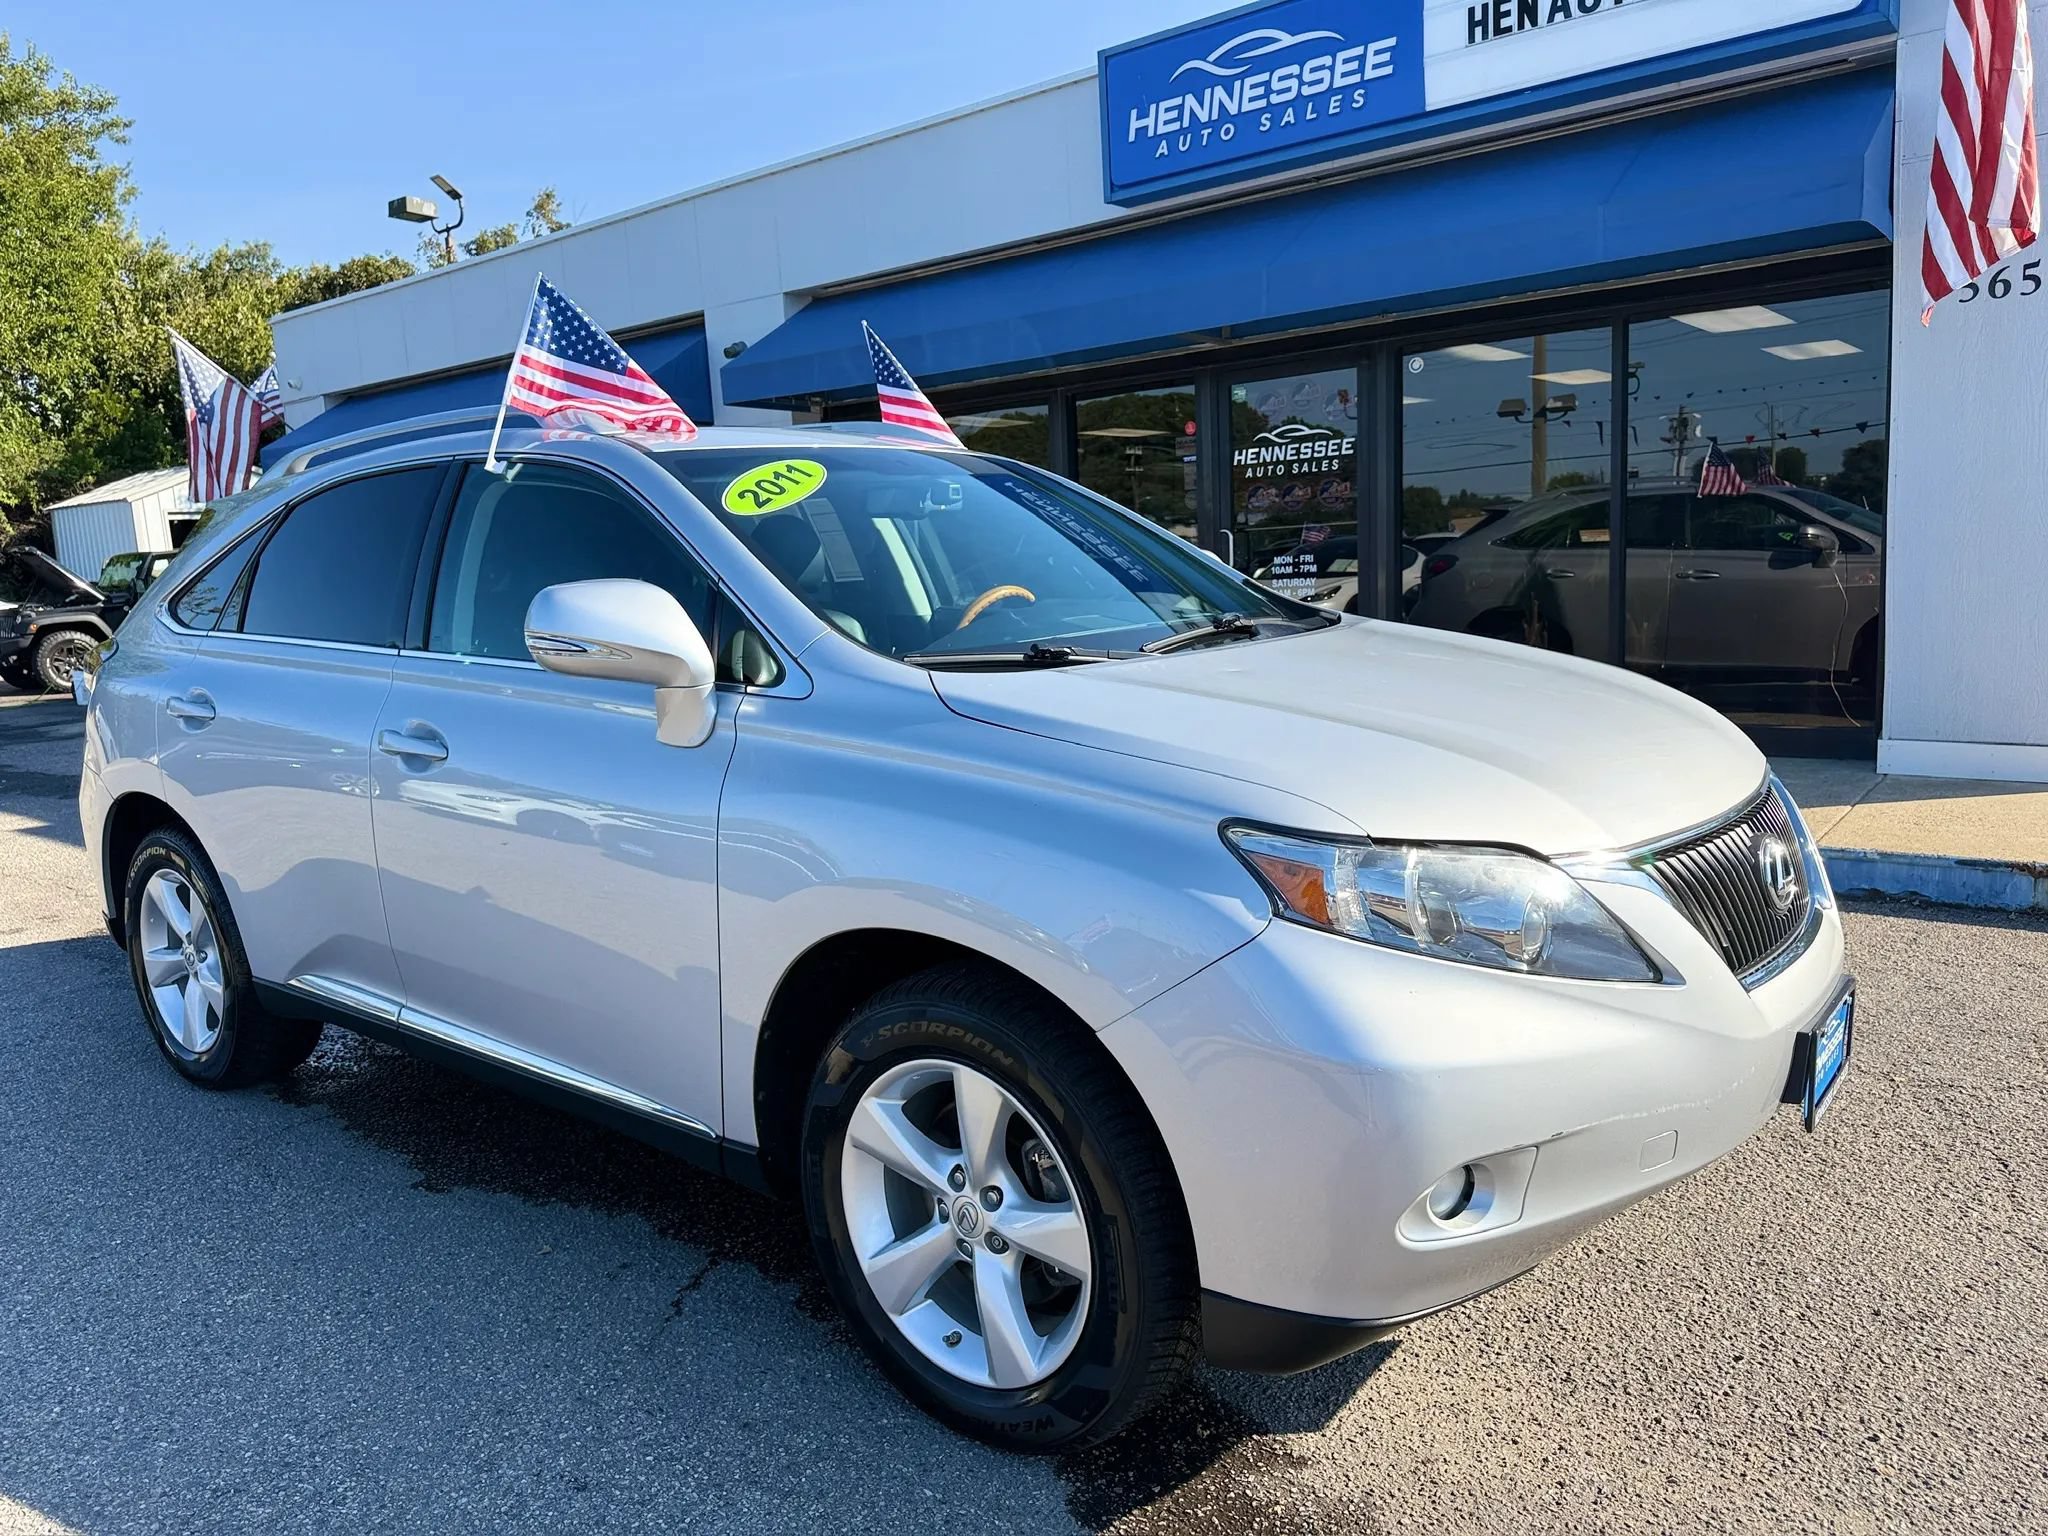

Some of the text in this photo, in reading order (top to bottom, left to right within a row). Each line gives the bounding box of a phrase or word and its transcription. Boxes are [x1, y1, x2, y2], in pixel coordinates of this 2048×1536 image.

[1128, 36, 1397, 142] HENNESSEE
[1155, 89, 1366, 158] AUTO SALES
[1233, 438, 1356, 465] HENNESSEE
[1245, 459, 1339, 478] AUTO SALES
[737, 463, 814, 509] 2011
[1271, 565, 1293, 574] 10AM
[1299, 564, 1317, 573] 7PM
[1273, 555, 1293, 564] MON
[1299, 554, 1314, 563] FRI
[1272, 577, 1316, 587] SATURDAY
[1297, 588, 1315, 597] 6PM
[130, 846, 167, 880] SCORPION
[878, 1021, 1014, 1065] SCORPION
